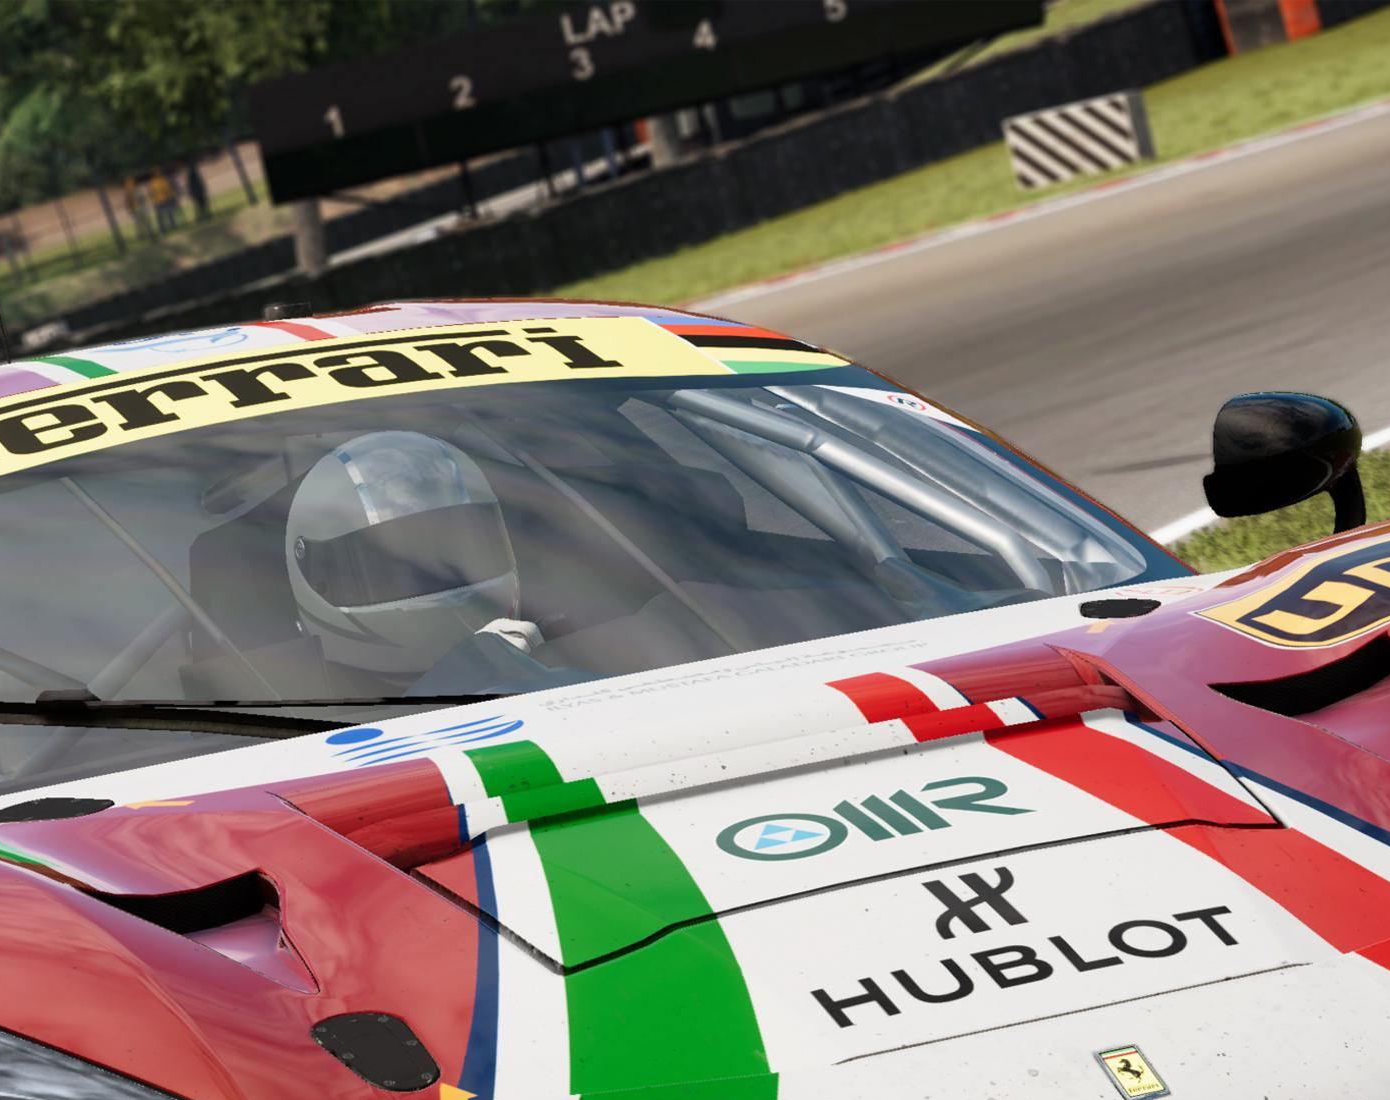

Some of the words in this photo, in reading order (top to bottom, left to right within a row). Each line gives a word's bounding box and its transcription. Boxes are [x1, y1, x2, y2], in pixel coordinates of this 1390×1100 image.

[324, 106, 346, 137] 1
[449, 76, 476, 109] 2
[569, 48, 594, 80] 3
[693, 20, 717, 48] 4
[561, 1, 636, 45] LAP
[810, 905, 1239, 1028] HUBLOT
